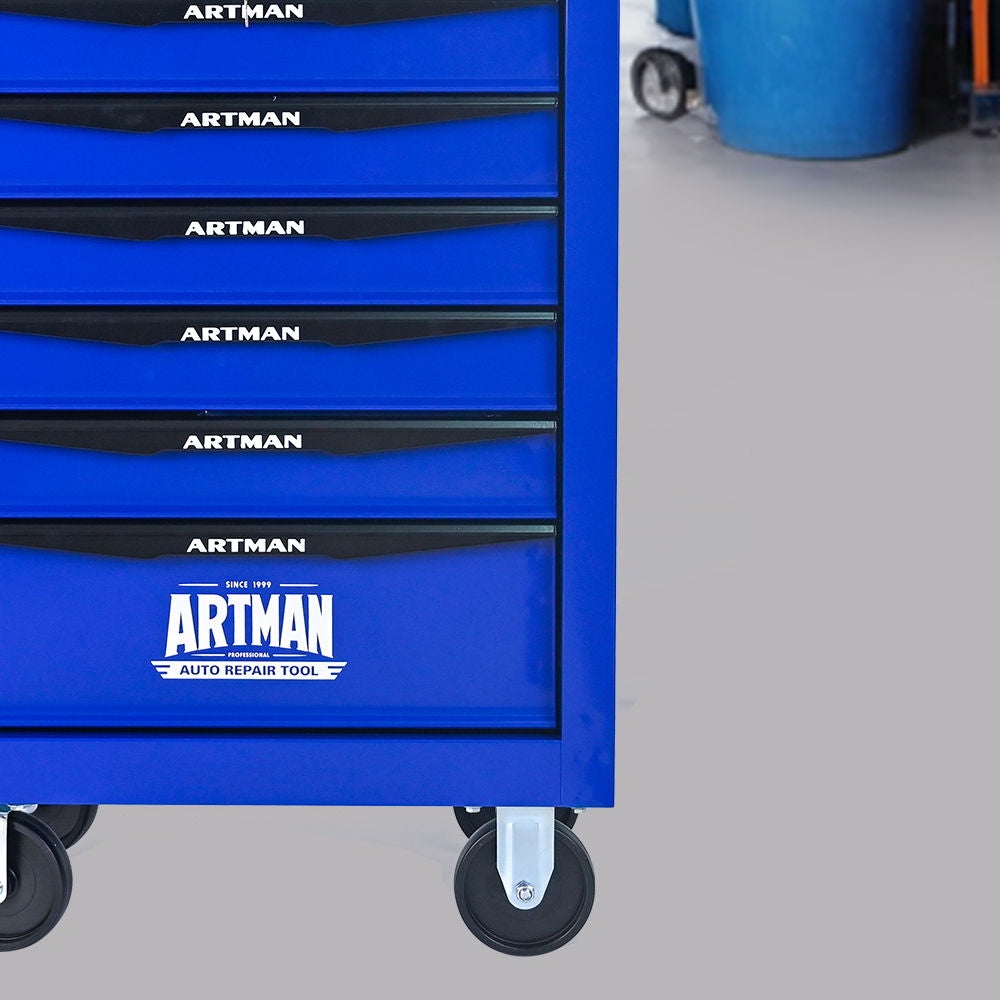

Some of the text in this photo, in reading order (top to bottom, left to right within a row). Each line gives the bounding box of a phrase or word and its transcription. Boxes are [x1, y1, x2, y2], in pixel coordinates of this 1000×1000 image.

[183, 4, 304, 19] ARTMAN
[180, 111, 301, 127] ARTMAN
[184, 220, 305, 236] ARTMAN
[180, 326, 300, 342] ARTMAN
[182, 434, 303, 450] ARTMAN
[186, 538, 306, 553] ARTMAN
[225, 580, 272, 589] SINCE 1999
[165, 594, 334, 659] ARTMAN
[179, 664, 319, 677] AUTO REPAIR TOOL
